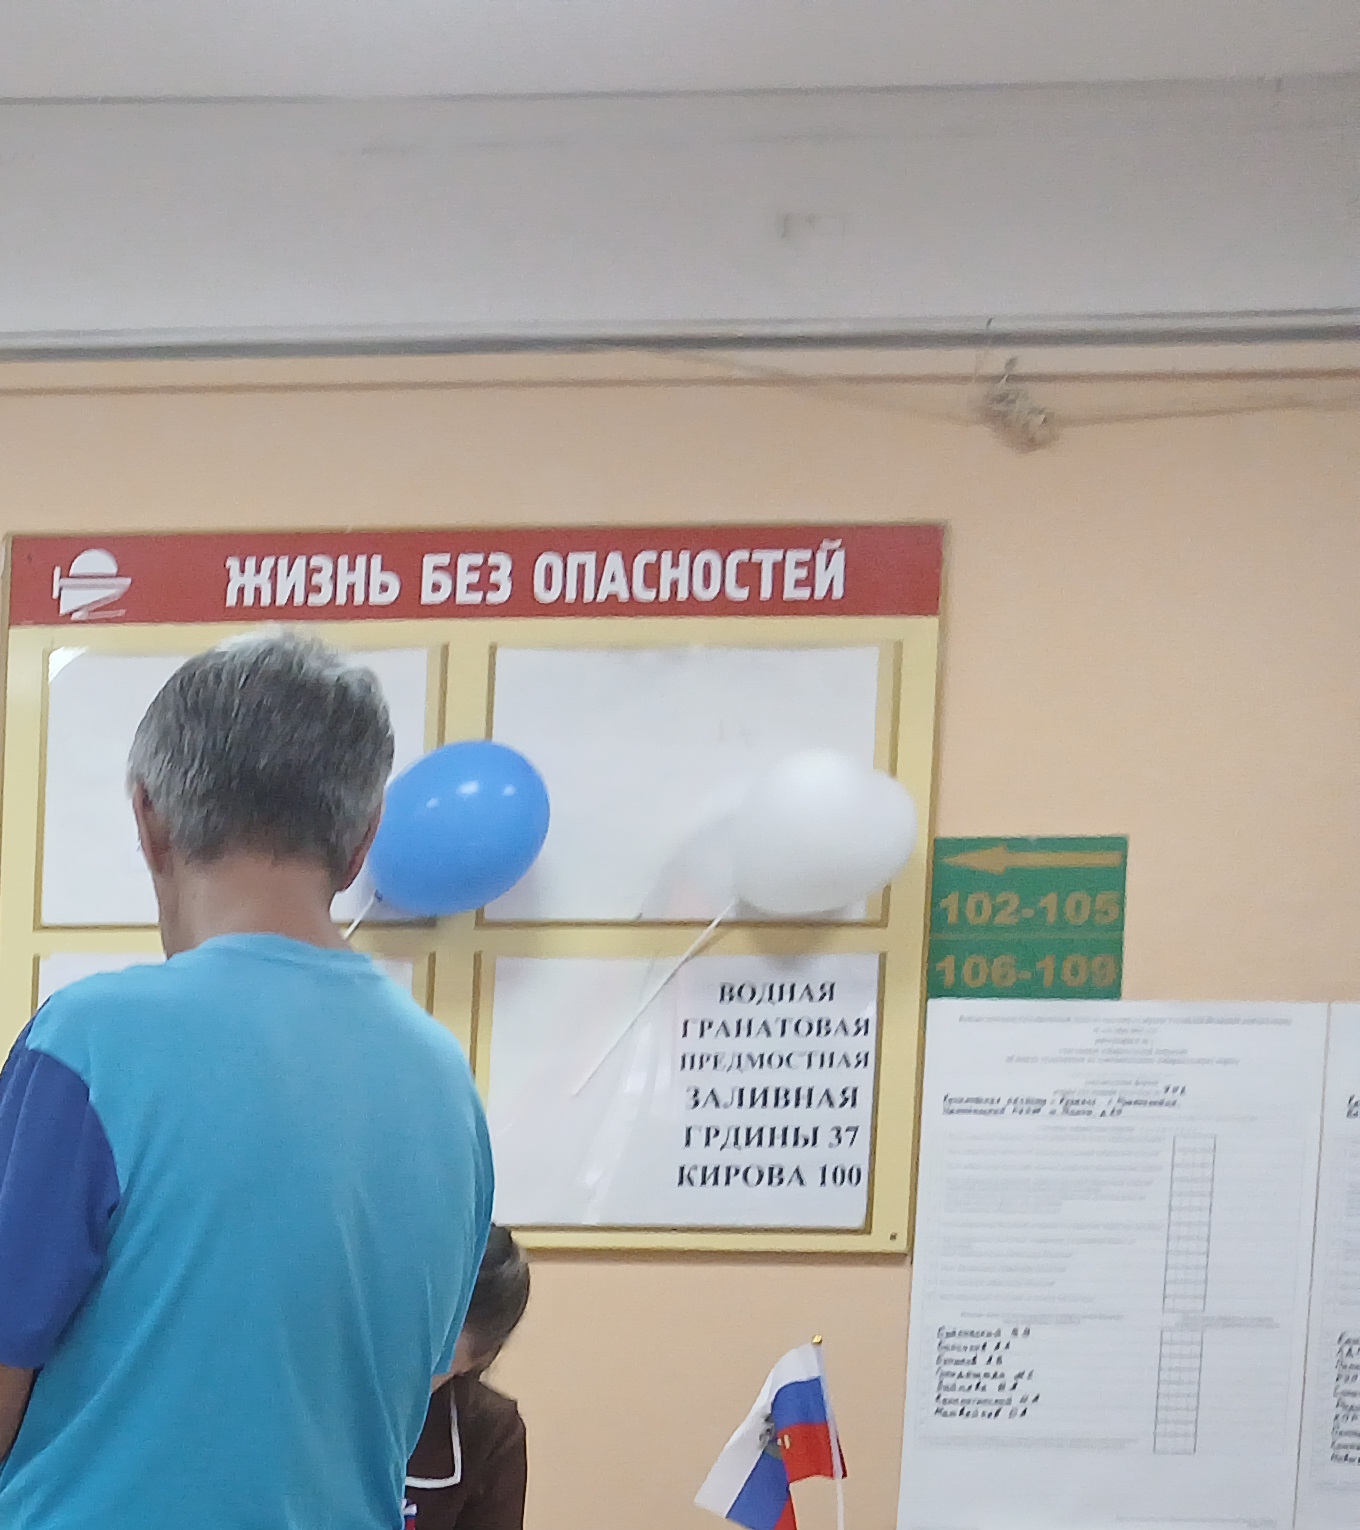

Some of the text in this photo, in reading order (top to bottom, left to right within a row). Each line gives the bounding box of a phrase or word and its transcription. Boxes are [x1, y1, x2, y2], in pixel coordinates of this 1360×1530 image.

[225, 539, 846, 607] ЖИЗНЬ БЕЗ ОПАСНОСТЕЙ
[939, 891, 1121, 926] 102-105
[935, 954, 1117, 988] 106-109
[718, 981, 837, 1006] ВОДНАЯ
[681, 1017, 871, 1039] ГРАНАТОВАЯ
[680, 1051, 870, 1074] ПРЕДМОСТНАЯ
[685, 1086, 859, 1110] ЗАЛИВНАЯ
[683, 1125, 860, 1151] ГРДИНЫ 37
[678, 1164, 863, 1188] КИРОВА 100
